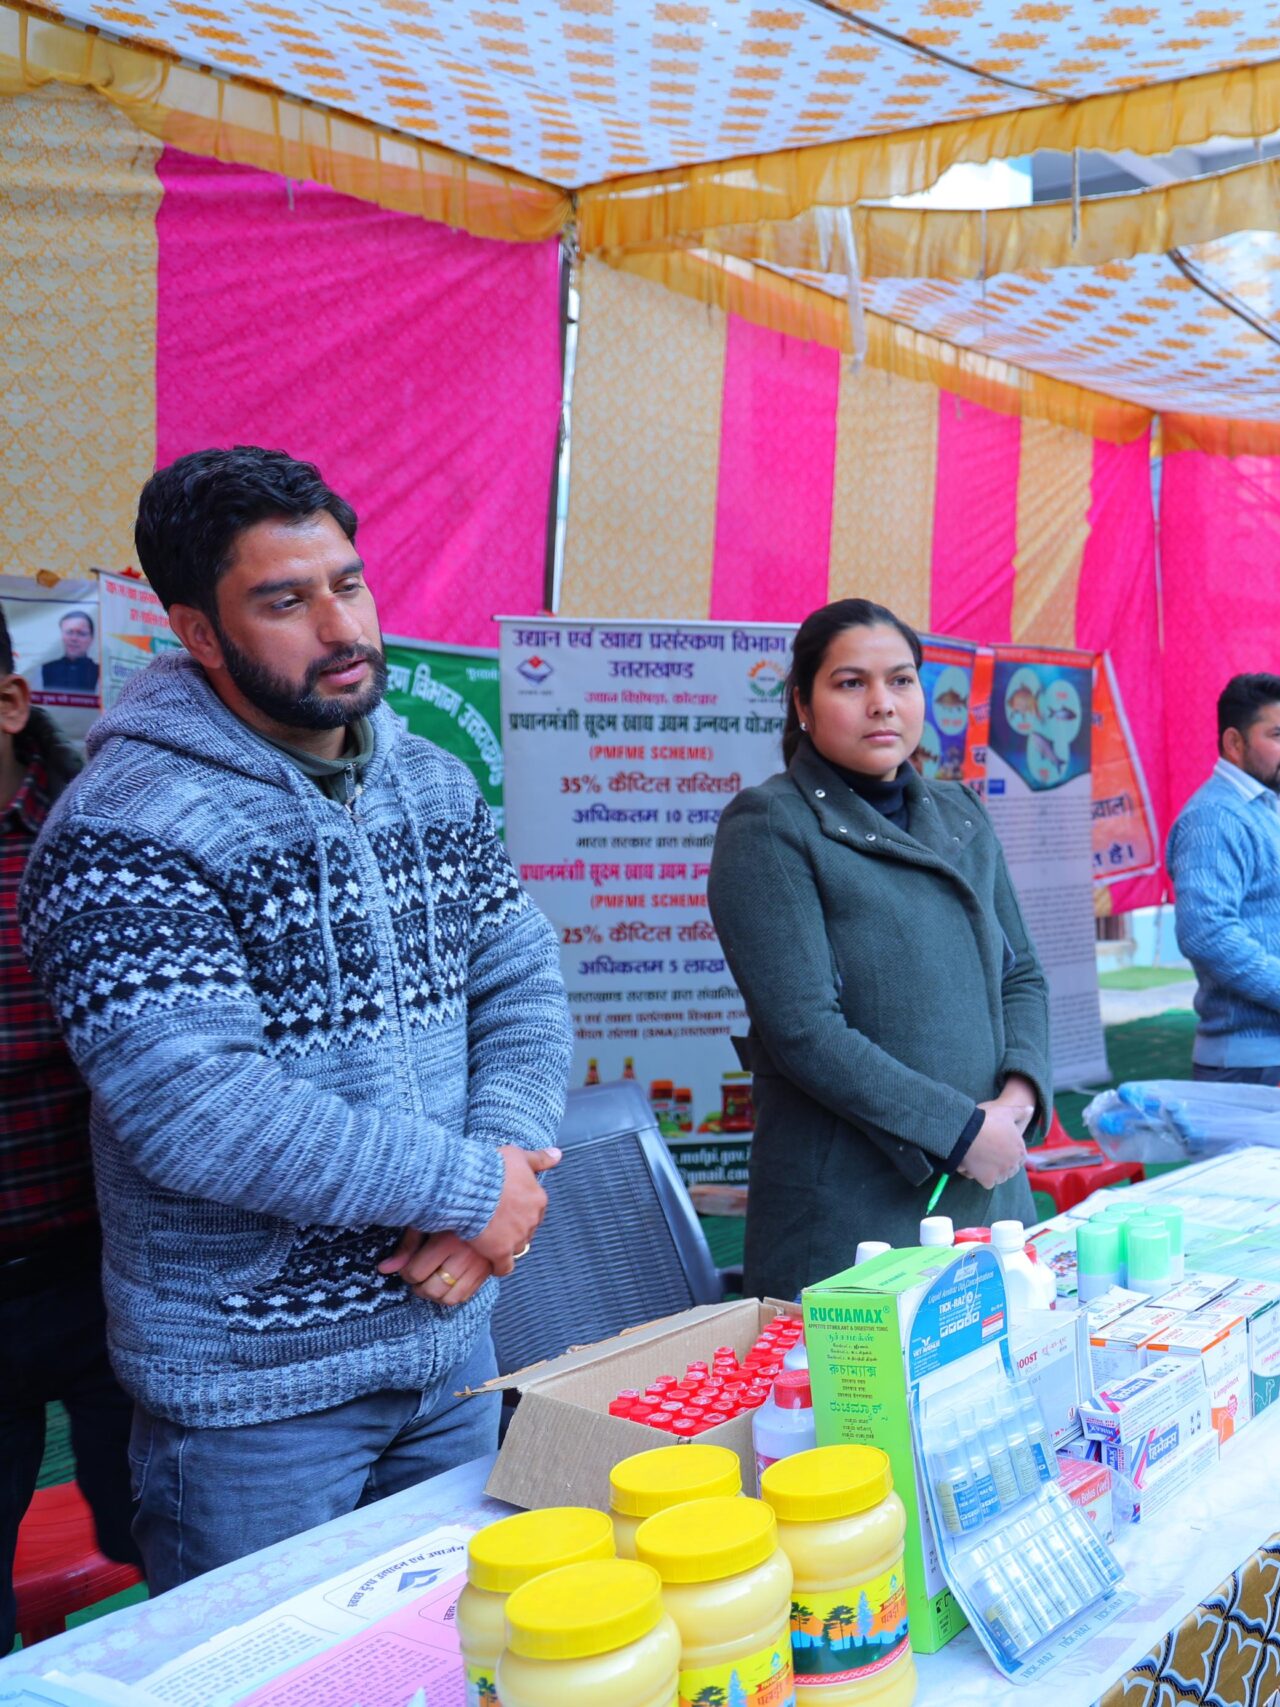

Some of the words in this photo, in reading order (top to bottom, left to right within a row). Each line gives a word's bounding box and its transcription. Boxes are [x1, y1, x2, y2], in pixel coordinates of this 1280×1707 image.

[567, 627, 594, 648] एवं
[732, 629, 787, 653] विभाग
[609, 660, 695, 680] उत्तराखण्ड
[650, 745, 715, 762] SCHEME)
[560, 775, 602, 794] 35%
[572, 803, 659, 825] अधिकतम
[666, 810, 682, 823] 10
[562, 926, 604, 945] 25%
[577, 955, 664, 977] अधिकतम
[683, 957, 726, 975] लाख
